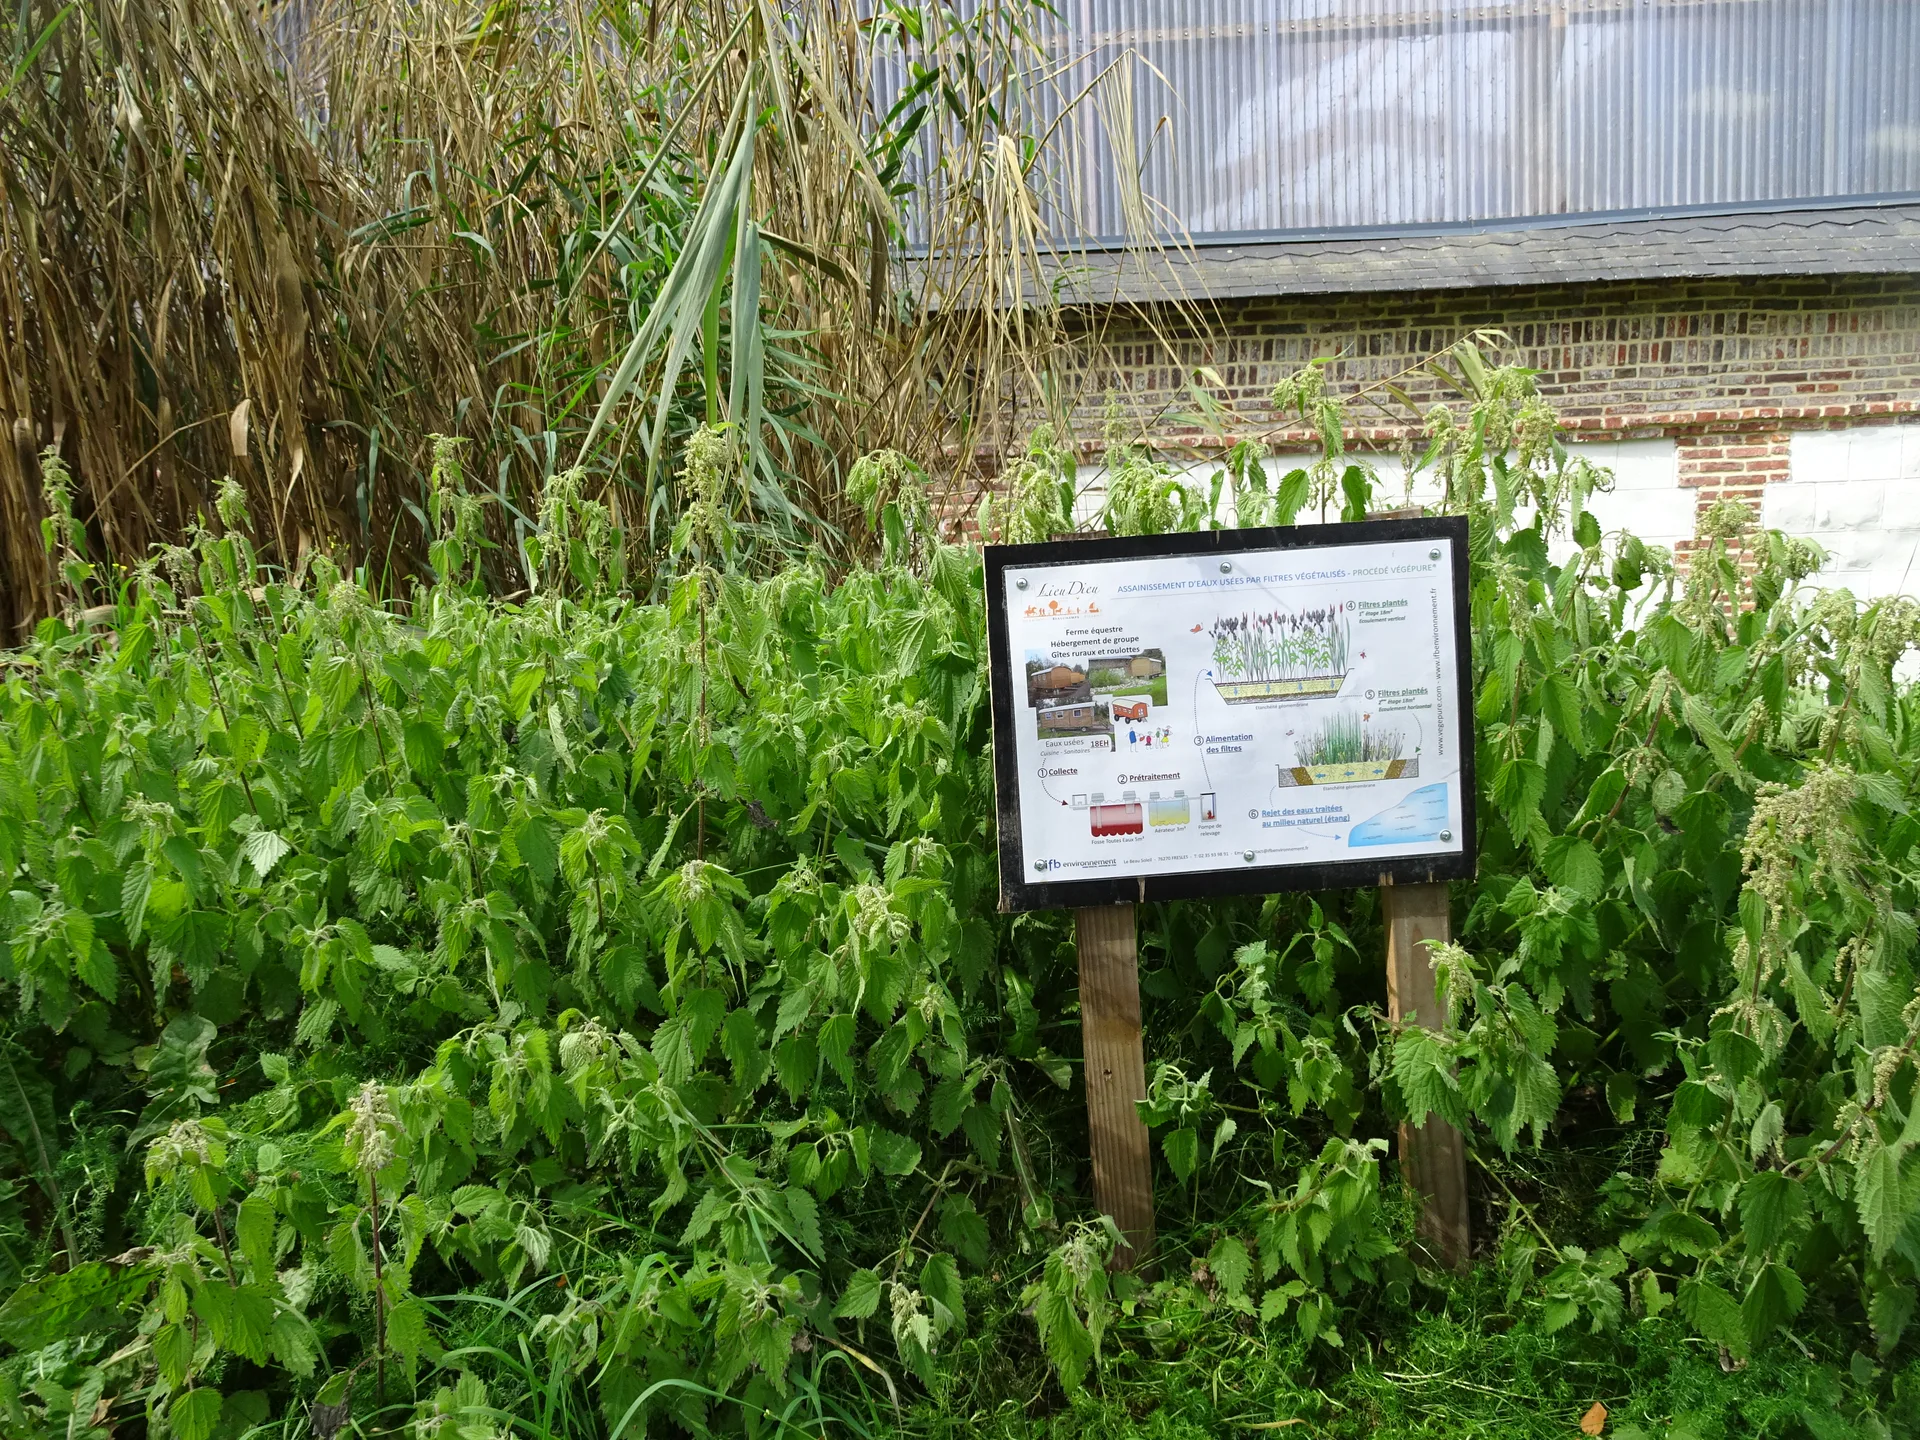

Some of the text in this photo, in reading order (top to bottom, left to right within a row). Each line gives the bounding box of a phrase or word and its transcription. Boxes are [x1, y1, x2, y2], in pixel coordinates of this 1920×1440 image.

[1117, 581, 1186, 593] ASSAINISSEMENT
[1188, 579, 1218, 588] D'EAUX
[1219, 576, 1244, 586] USÉES
[1263, 574, 1293, 583] FILTRES
[1295, 570, 1346, 581] VÉGÉTALISÉS
[1352, 566, 1389, 577] PROCÉDÉ
[1358, 602, 1380, 610] Filtres
[1382, 599, 1408, 608] plantés
[1066, 626, 1123, 636] Ferme équestre
[1430, 588, 1441, 680] www.ifbenvironnement.fr
[1050, 638, 1101, 648] Hébergement
[1114, 636, 1140, 646] groupe
[1051, 651, 1070, 659] Gîtes
[1106, 646, 1140, 655] roulottes
[1378, 690, 1400, 698] Filtres
[1401, 687, 1428, 697] plantés
[1436, 686, 1444, 756] www.vegepure.com
[1046, 738, 1110, 748] Eaux usées 18EH
[1206, 734, 1253, 743] Alimentation
[1206, 744, 1242, 754] des filtres
[1048, 768, 1078, 776] Collecte
[1130, 772, 1180, 782] Prétraitement
[1262, 809, 1280, 818] Rejet
[1315, 804, 1343, 813] traitées
[1273, 818, 1296, 827] milieu
[1297, 816, 1323, 826] naturel
[1324, 814, 1350, 824] (étang)
[1062, 859, 1117, 868] environnement
